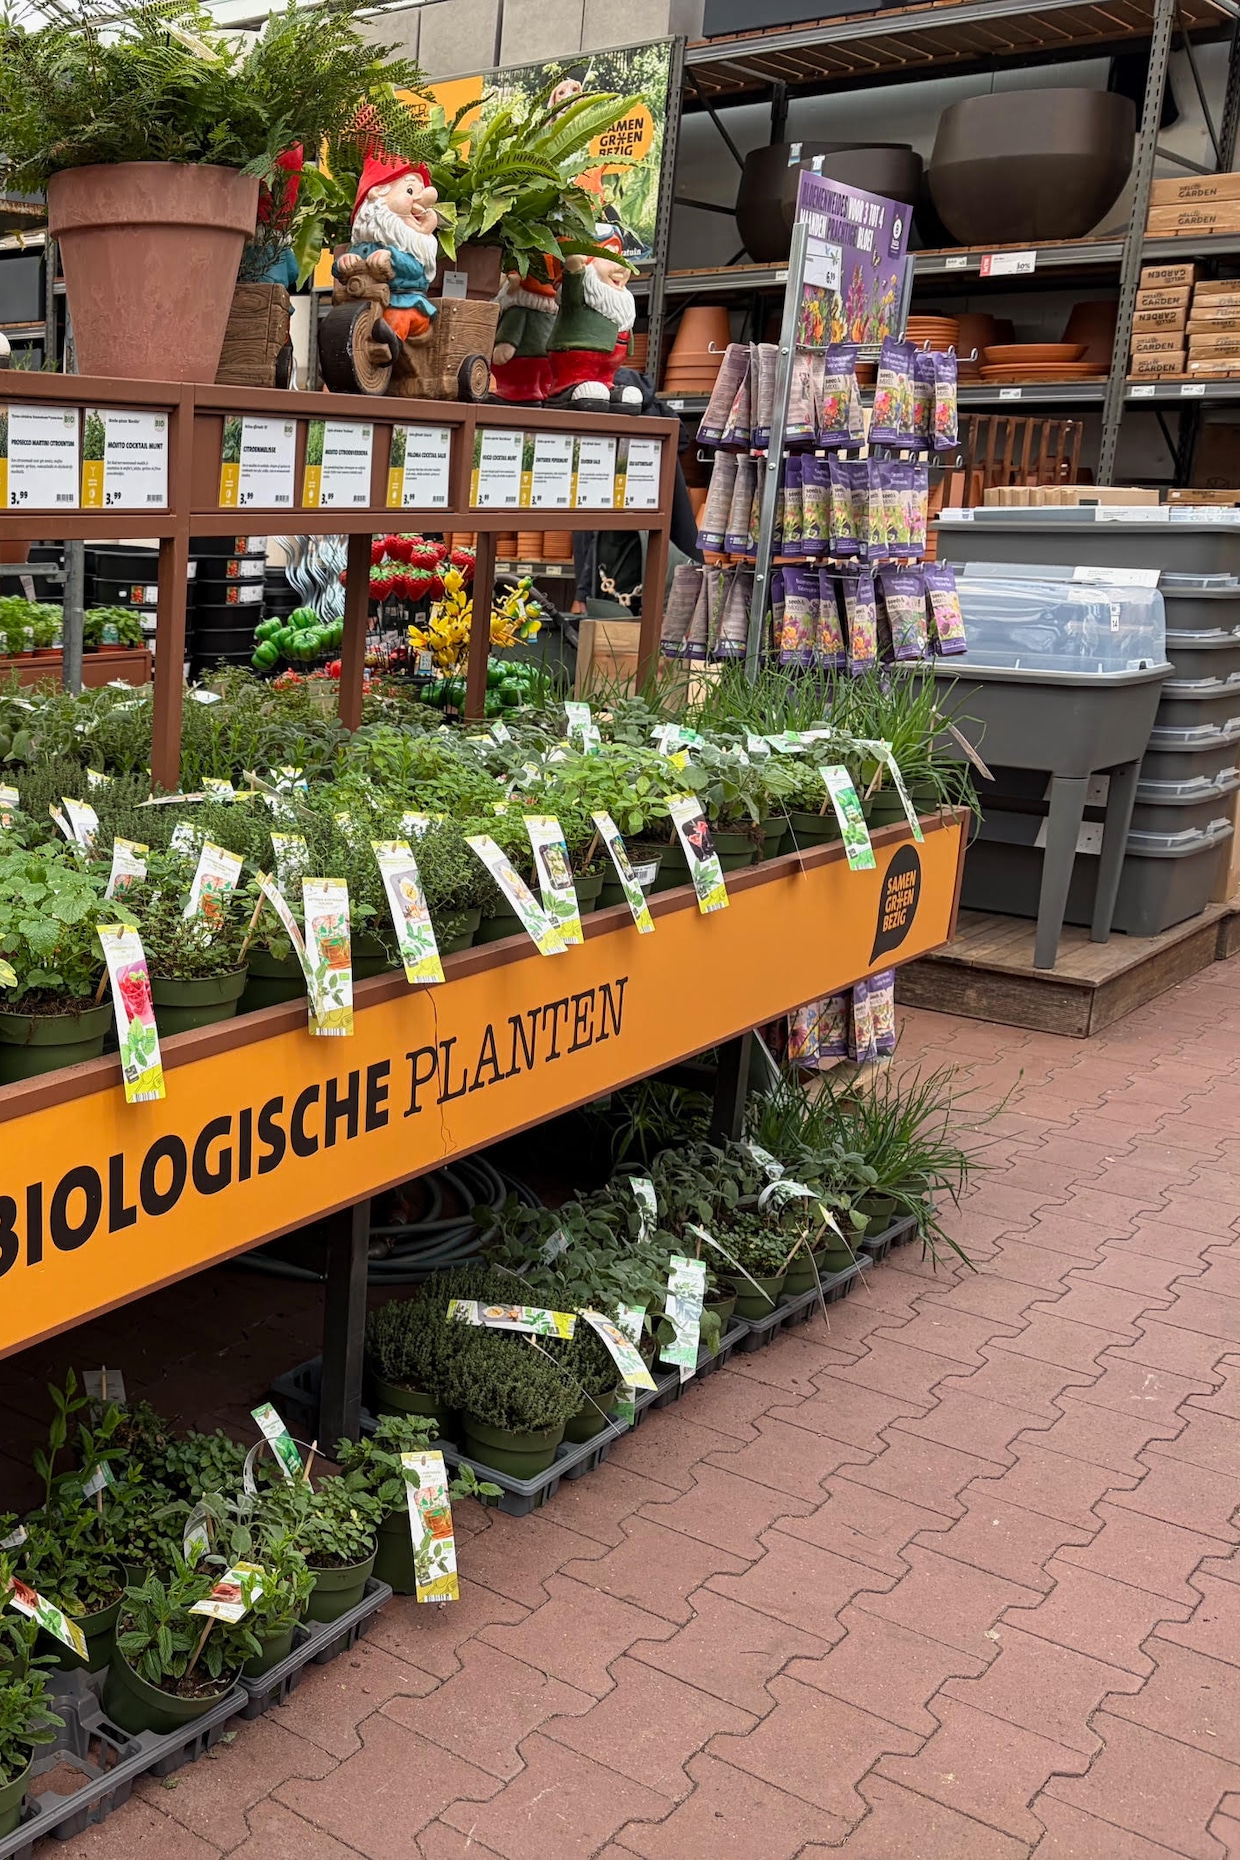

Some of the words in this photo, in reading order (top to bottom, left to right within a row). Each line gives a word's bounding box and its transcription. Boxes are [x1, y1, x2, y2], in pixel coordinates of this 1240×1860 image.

[607, 118, 644, 132] AMEN
[1178, 188, 1217, 198] GARDEN
[848, 196, 864, 224] VOOR
[863, 202, 869, 224] 3
[869, 203, 880, 228] TOT
[878, 206, 885, 229] 4
[1178, 216, 1216, 225] GARDEN
[1142, 297, 1180, 306] GARDEN
[1136, 342, 1174, 351] GARDEN
[1138, 364, 1176, 372] GARDEN
[64, 416, 75, 424] BIO
[155, 420, 164, 428] BIO
[10, 490, 28, 504] 3.99
[106, 492, 122, 504] 3.99
[240, 492, 254, 505] 3.99
[321, 492, 334, 504] 3.99
[886, 870, 916, 896] SAMEN
[882, 908, 907, 932] BEZIG
[402, 976, 628, 1119] PLANTEN
